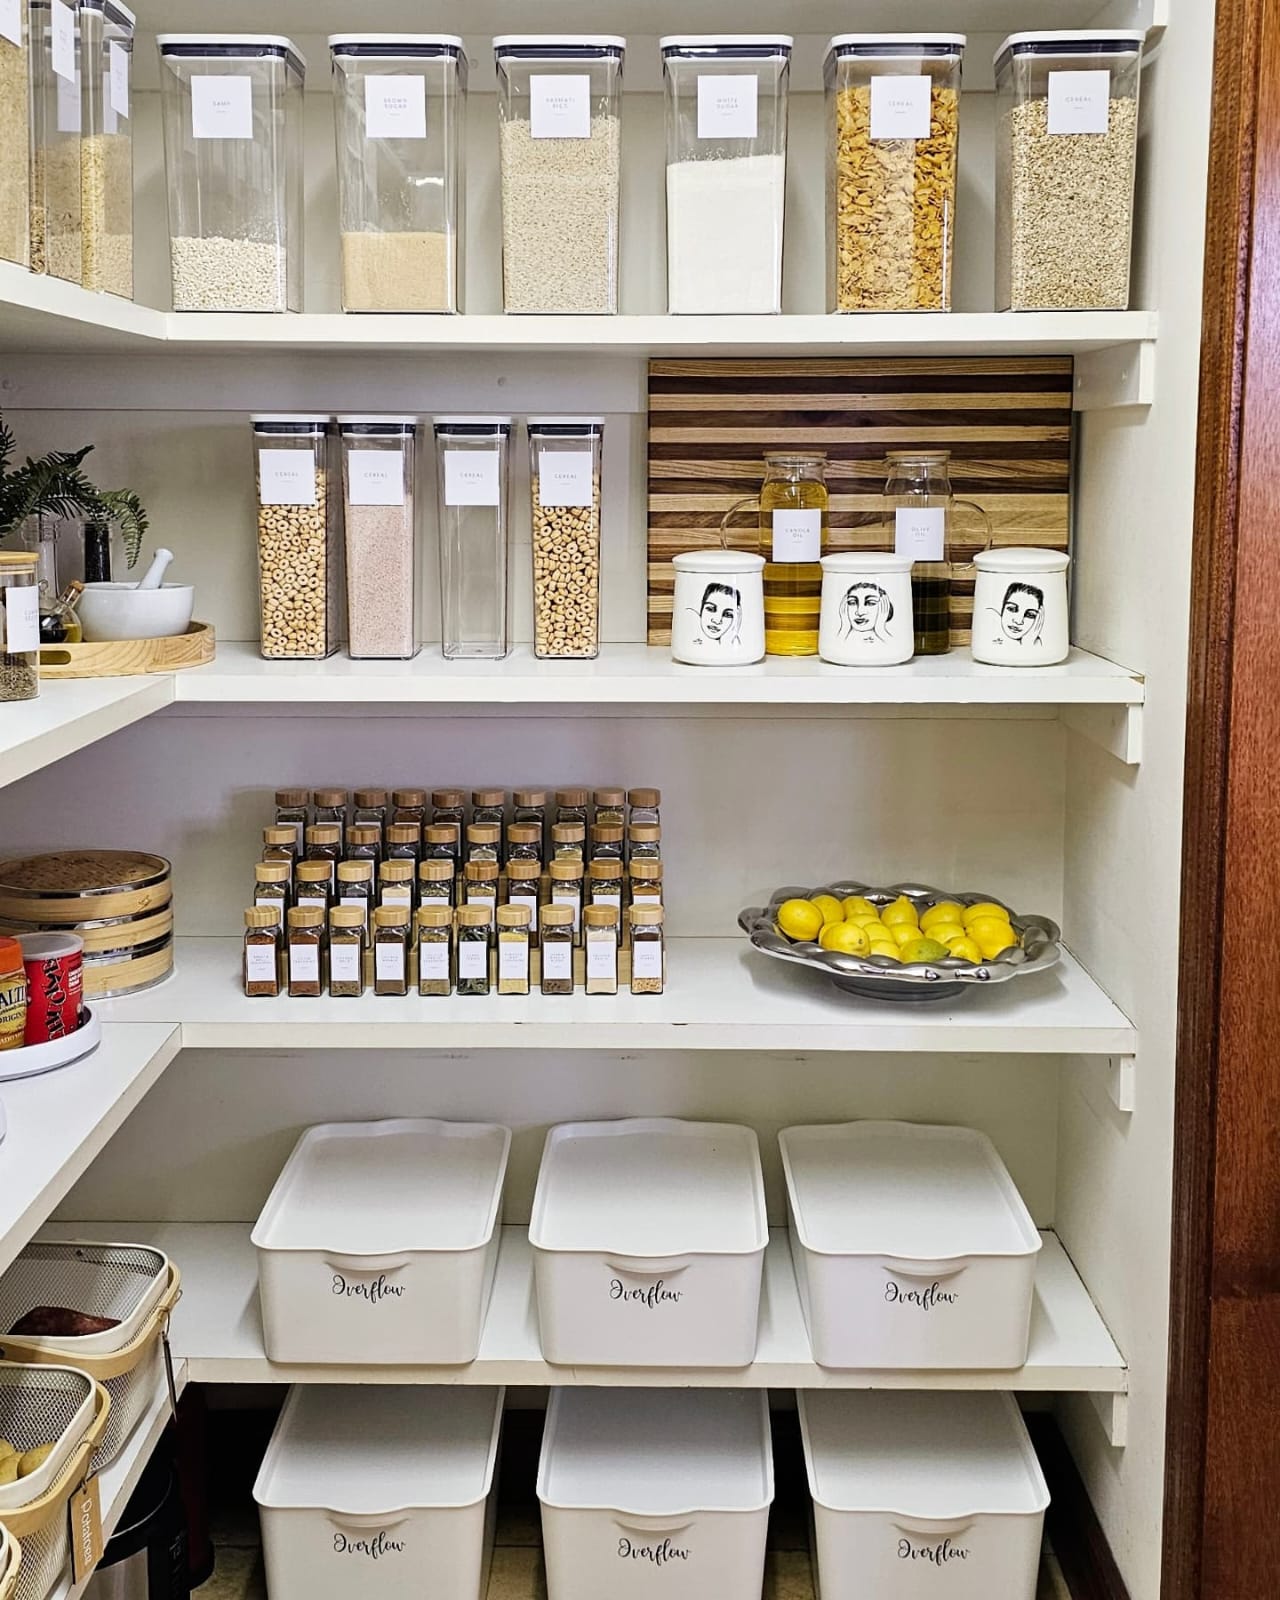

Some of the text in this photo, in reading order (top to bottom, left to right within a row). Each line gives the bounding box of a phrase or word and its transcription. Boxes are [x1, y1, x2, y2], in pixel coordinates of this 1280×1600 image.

[331, 1274, 407, 1305] Overflow
[609, 1278, 685, 1310] Overflow
[884, 1280, 960, 1311] Overflow
[80, 1496, 93, 1566] Potatoes
[332, 1530, 407, 1560] Overflow
[617, 1537, 692, 1567] Overflow
[897, 1537, 971, 1568] Overflow
